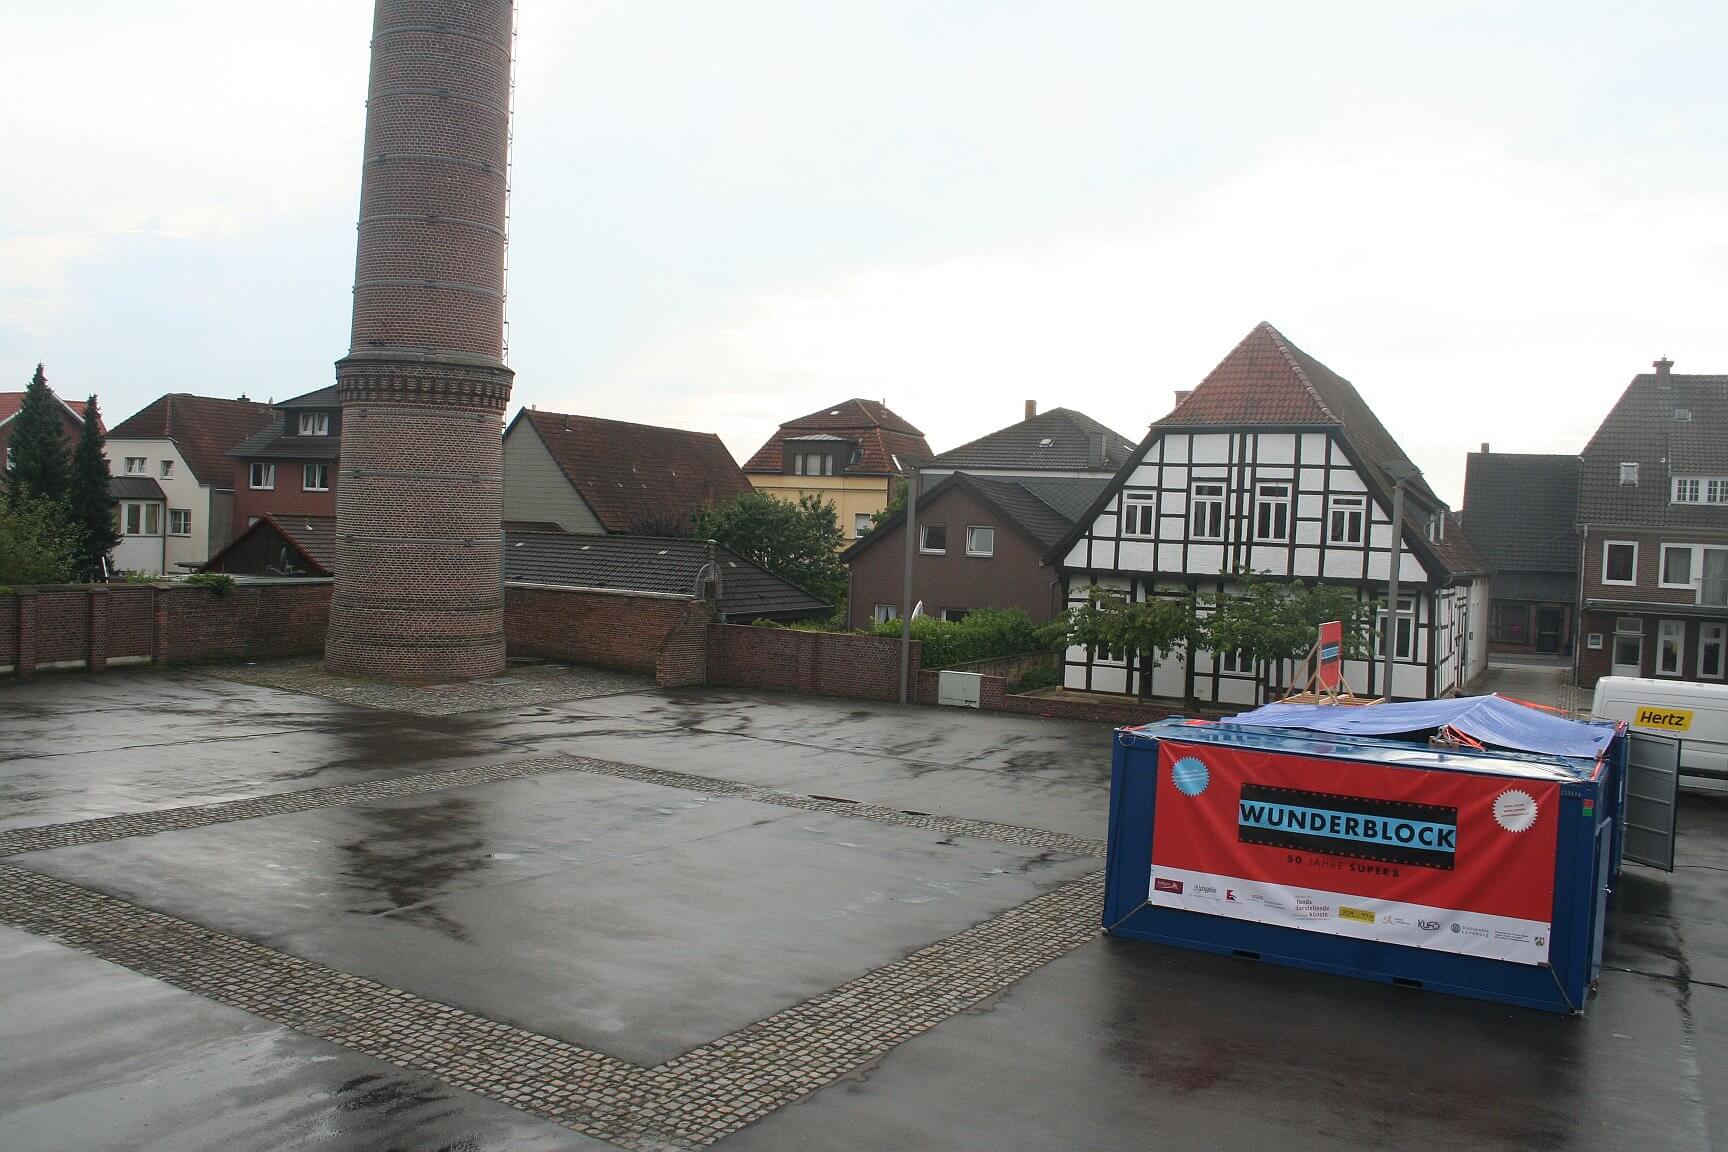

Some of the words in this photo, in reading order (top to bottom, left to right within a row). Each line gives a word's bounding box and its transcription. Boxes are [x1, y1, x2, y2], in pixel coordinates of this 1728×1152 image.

[1640, 711, 1685, 726] Hertz
[1240, 803, 1456, 848] WUNDERBLOCK
[1287, 854, 1302, 864] 50
[1307, 857, 1345, 871] JAHRE
